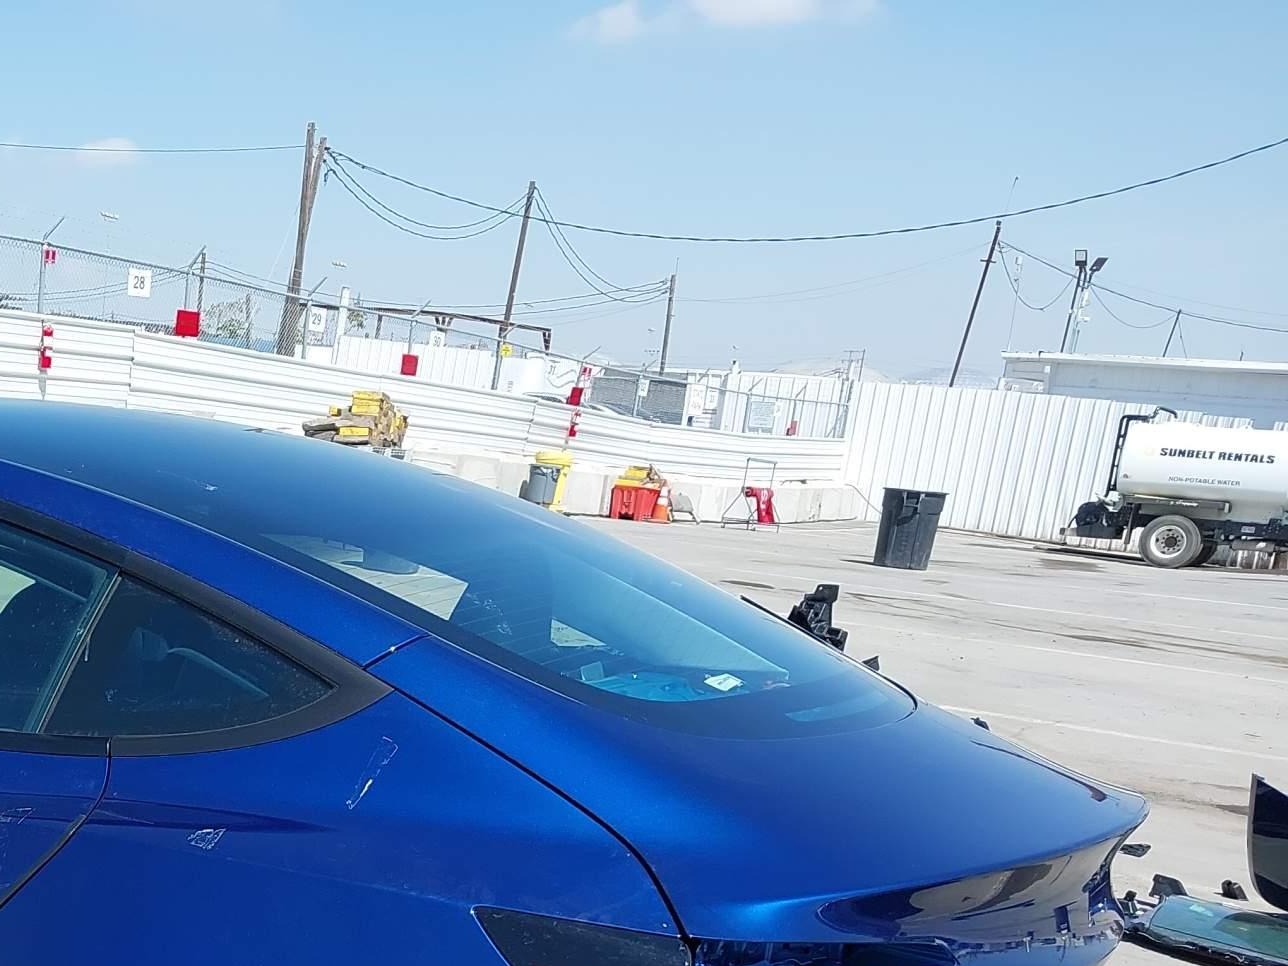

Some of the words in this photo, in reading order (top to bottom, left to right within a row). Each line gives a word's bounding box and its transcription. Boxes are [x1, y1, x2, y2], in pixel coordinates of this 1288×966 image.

[133, 275, 146, 290] 28
[311, 312, 322, 326] 29
[1160, 447, 1216, 460] SUNBELT
[1218, 451, 1276, 464] RENTALS
[1168, 476, 1216, 485] NON-POTABLE
